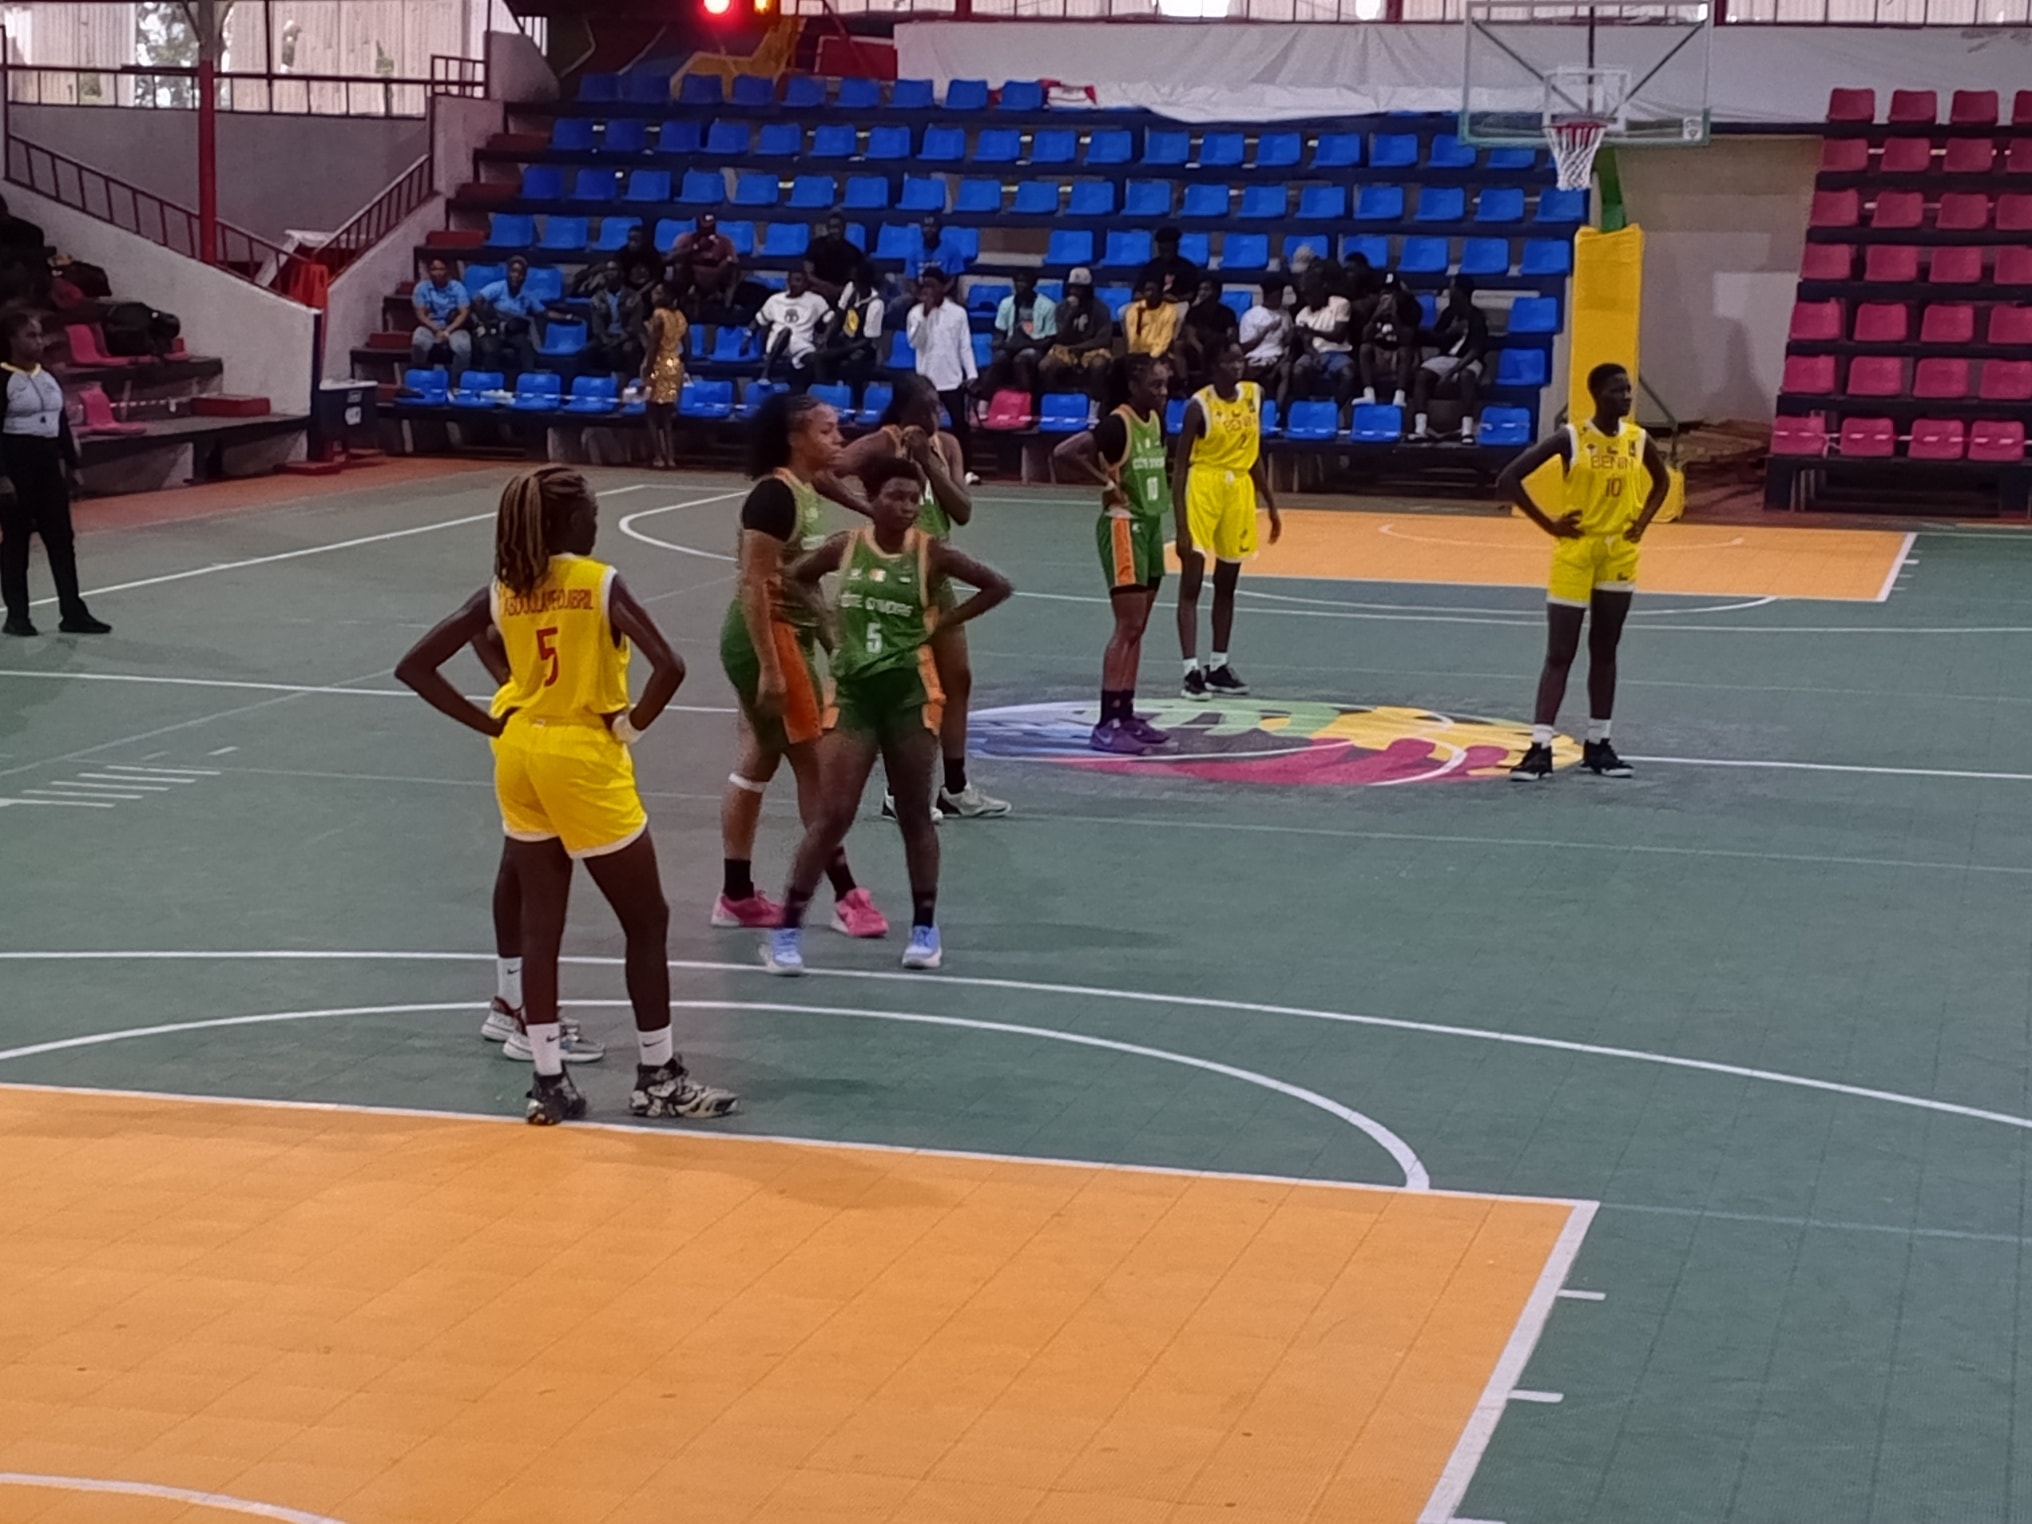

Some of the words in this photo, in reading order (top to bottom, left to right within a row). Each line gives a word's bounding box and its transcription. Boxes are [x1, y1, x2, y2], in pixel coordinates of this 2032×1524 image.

[1605, 478, 1621, 497] 10
[866, 622, 882, 653] 5
[536, 627, 558, 687] 5
